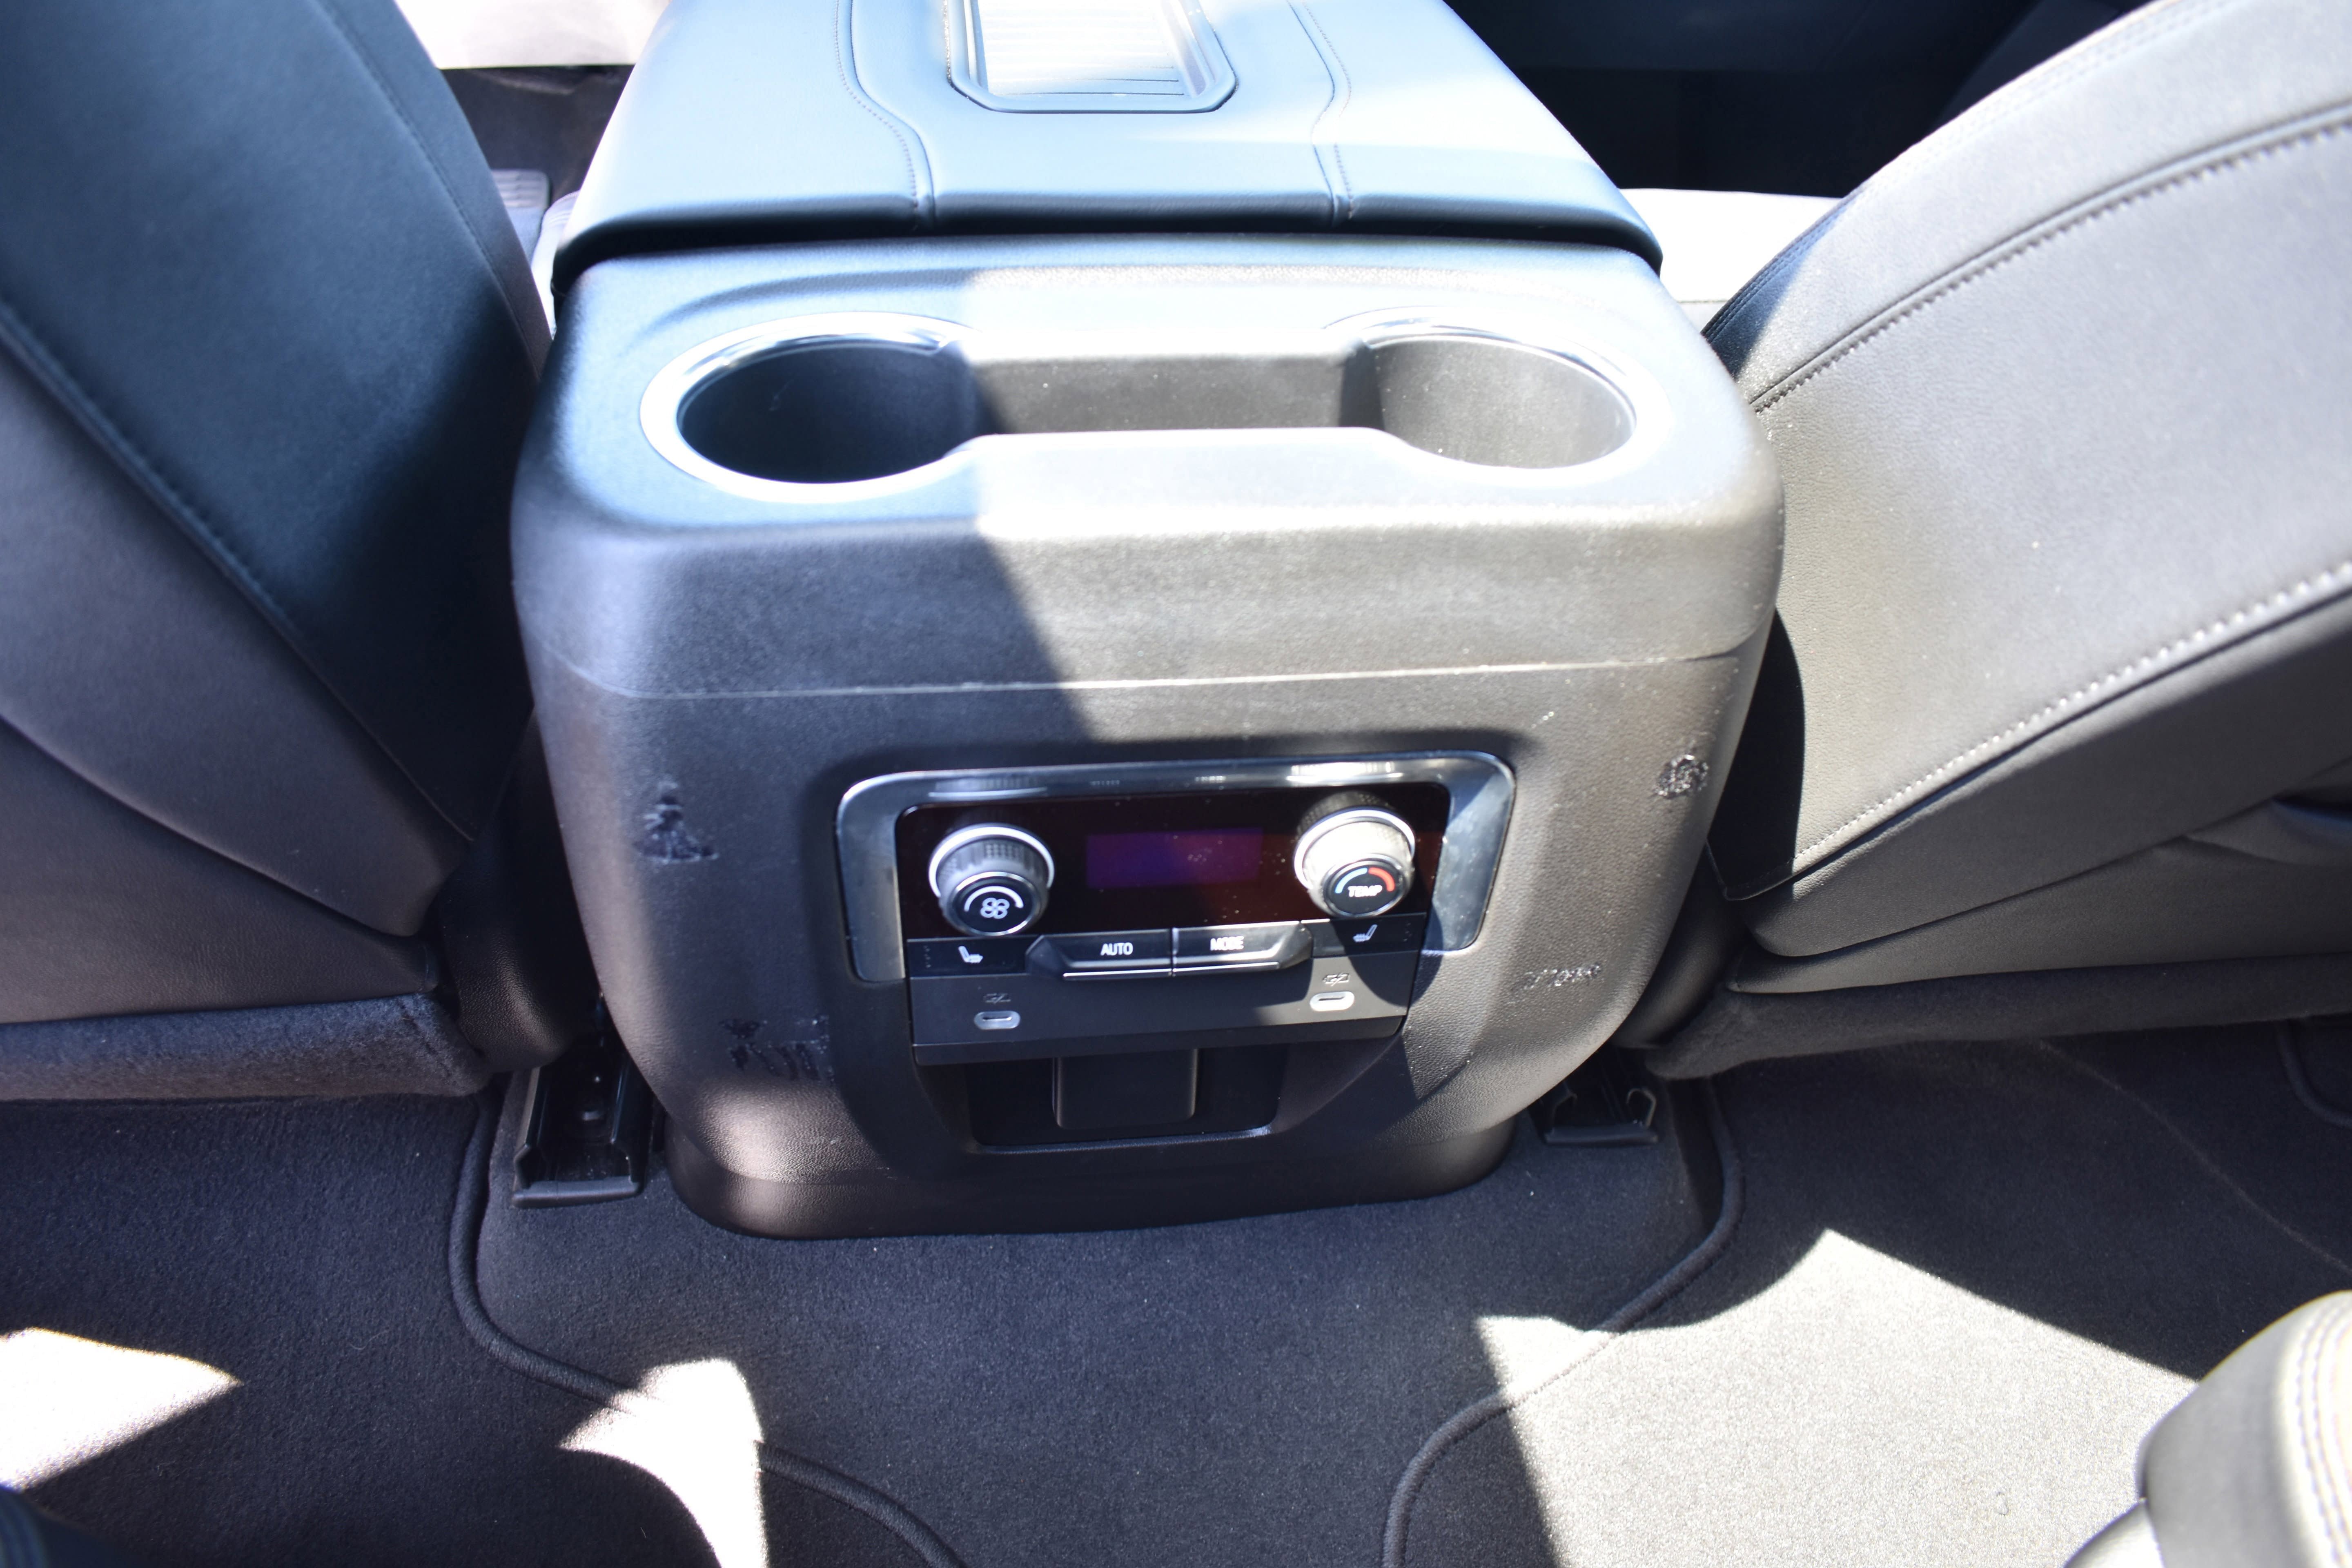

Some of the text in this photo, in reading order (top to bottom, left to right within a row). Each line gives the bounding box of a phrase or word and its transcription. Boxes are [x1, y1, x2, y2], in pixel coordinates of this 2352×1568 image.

[1348, 885, 1383, 898] TEMP
[1100, 942, 1134, 956] AUTO
[1210, 935, 1245, 951] MODE
